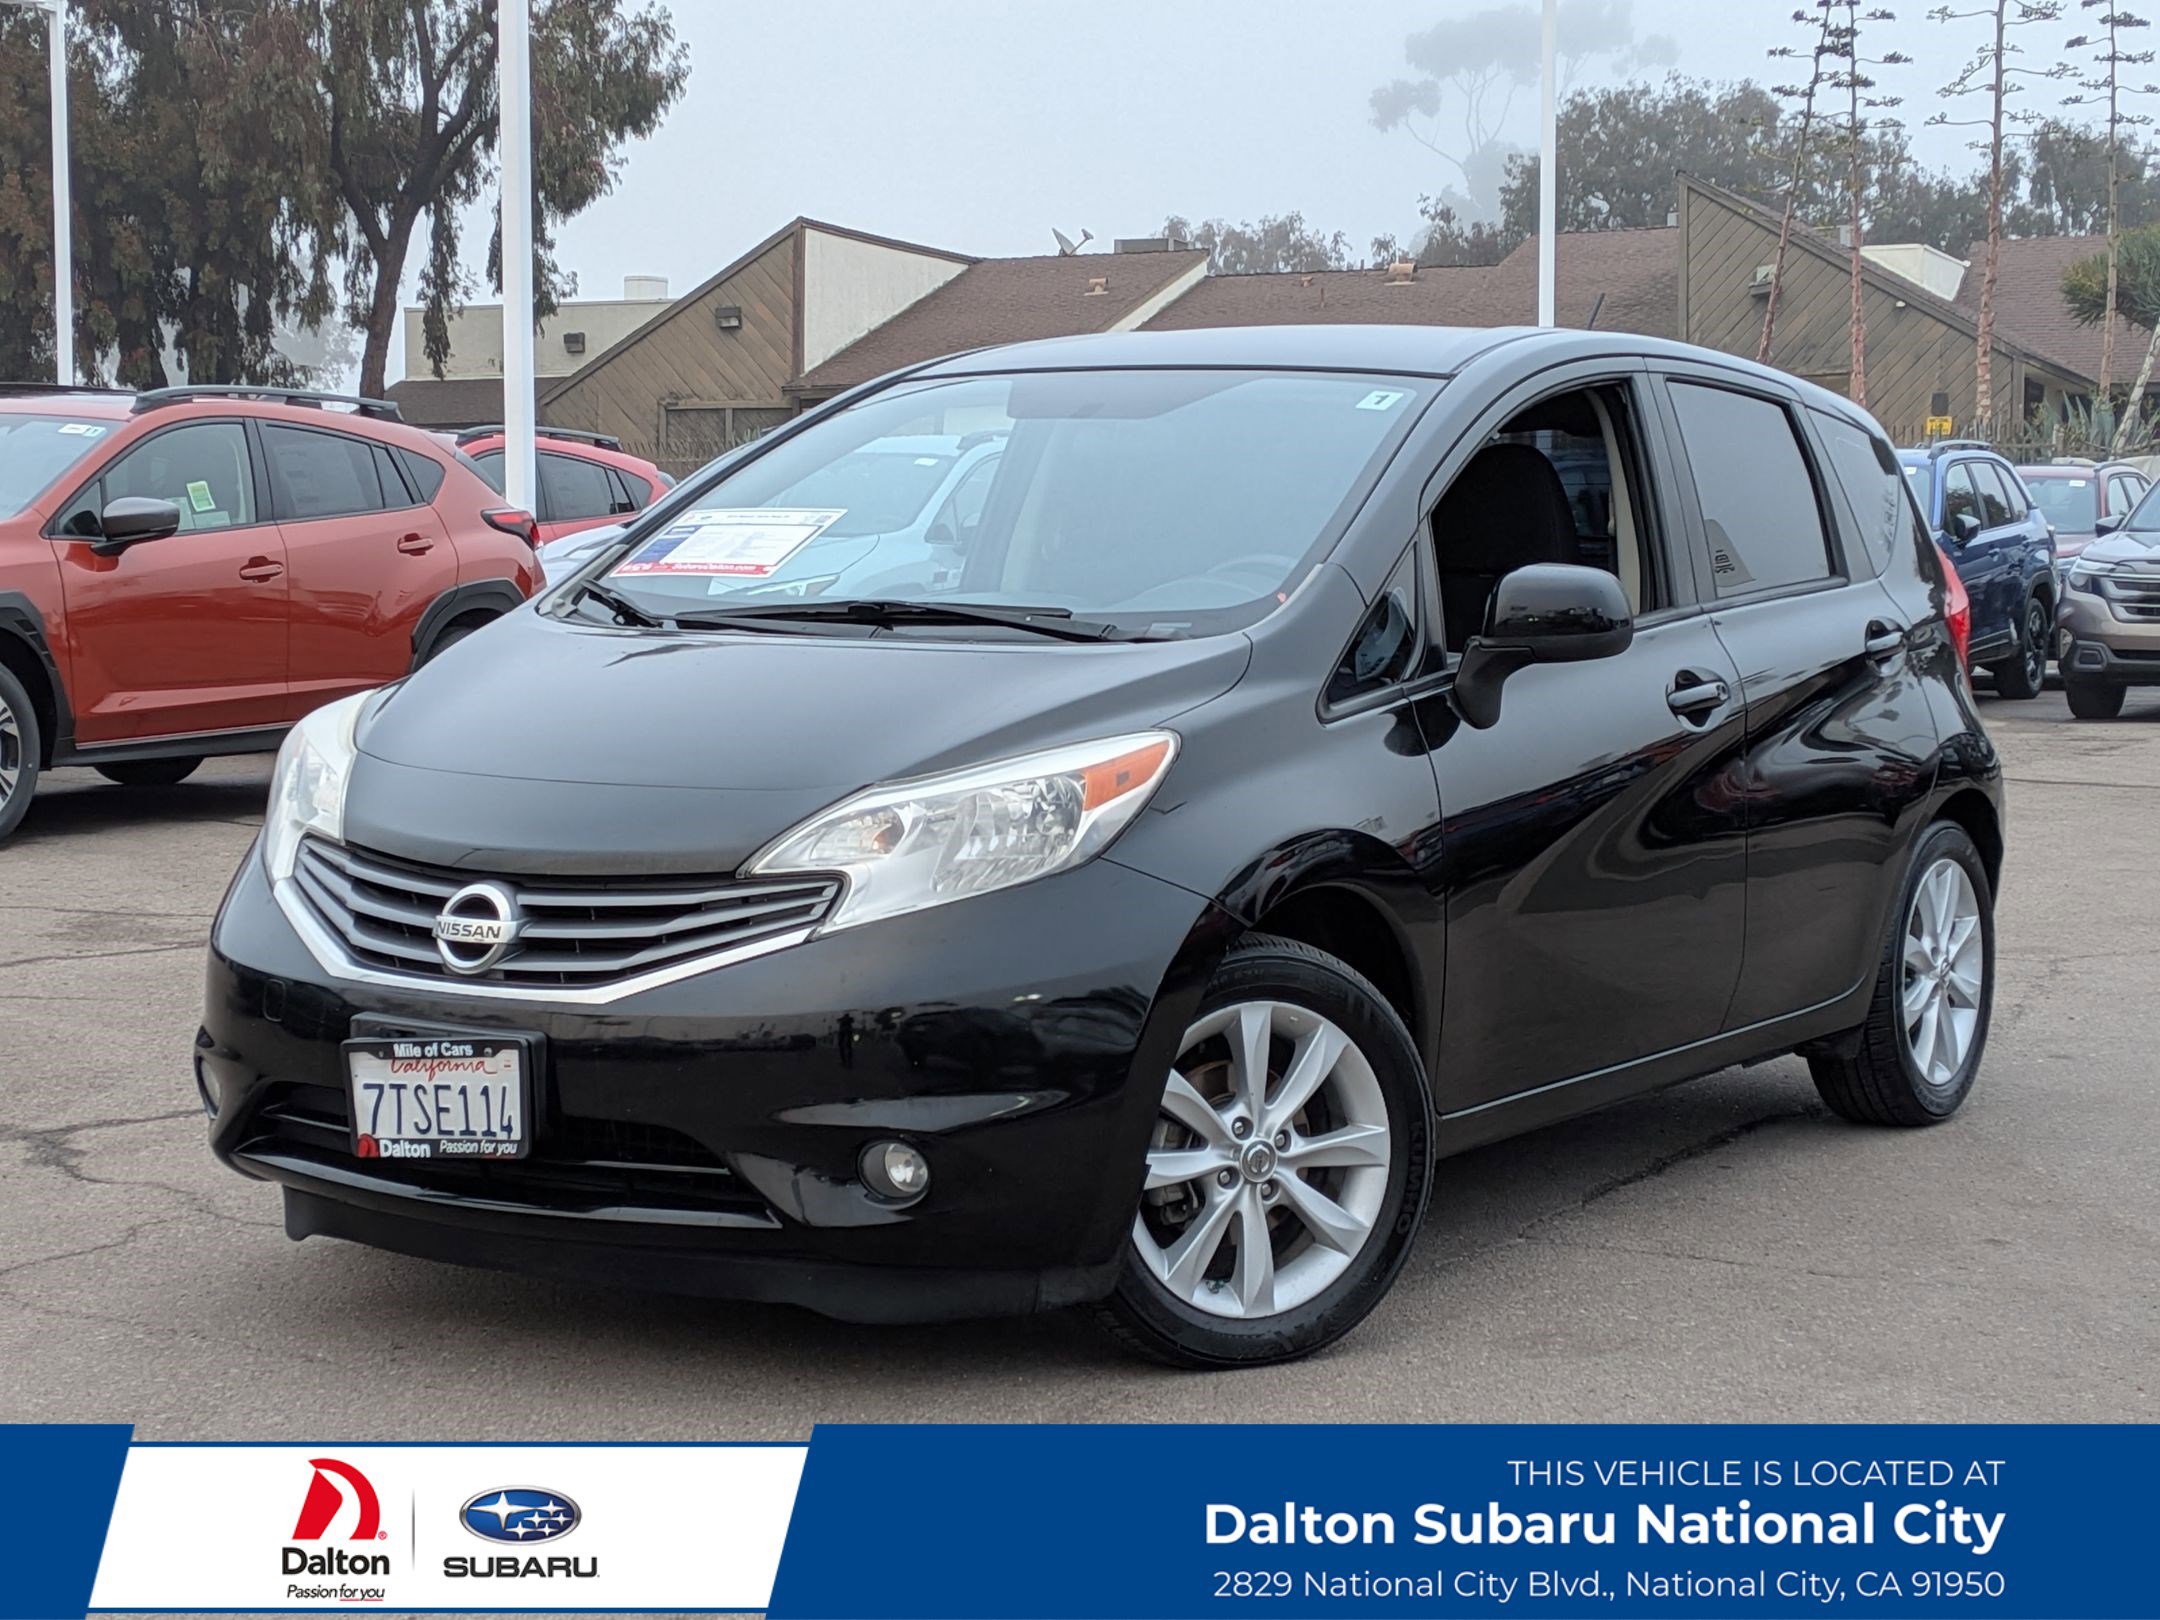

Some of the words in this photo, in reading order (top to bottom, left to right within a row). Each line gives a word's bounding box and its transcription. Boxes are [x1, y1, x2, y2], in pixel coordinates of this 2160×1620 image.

[438, 922, 502, 939] NISSAN
[393, 1043, 422, 1058] Mile
[424, 1042, 439, 1058] of
[441, 1043, 474, 1057] Cars
[390, 1059, 498, 1082] California
[363, 1083, 514, 1140] 7TSE114
[379, 1139, 431, 1158] Dalton
[439, 1140, 478, 1154] Passion
[480, 1140, 496, 1155] for
[496, 1142, 518, 1156] you
